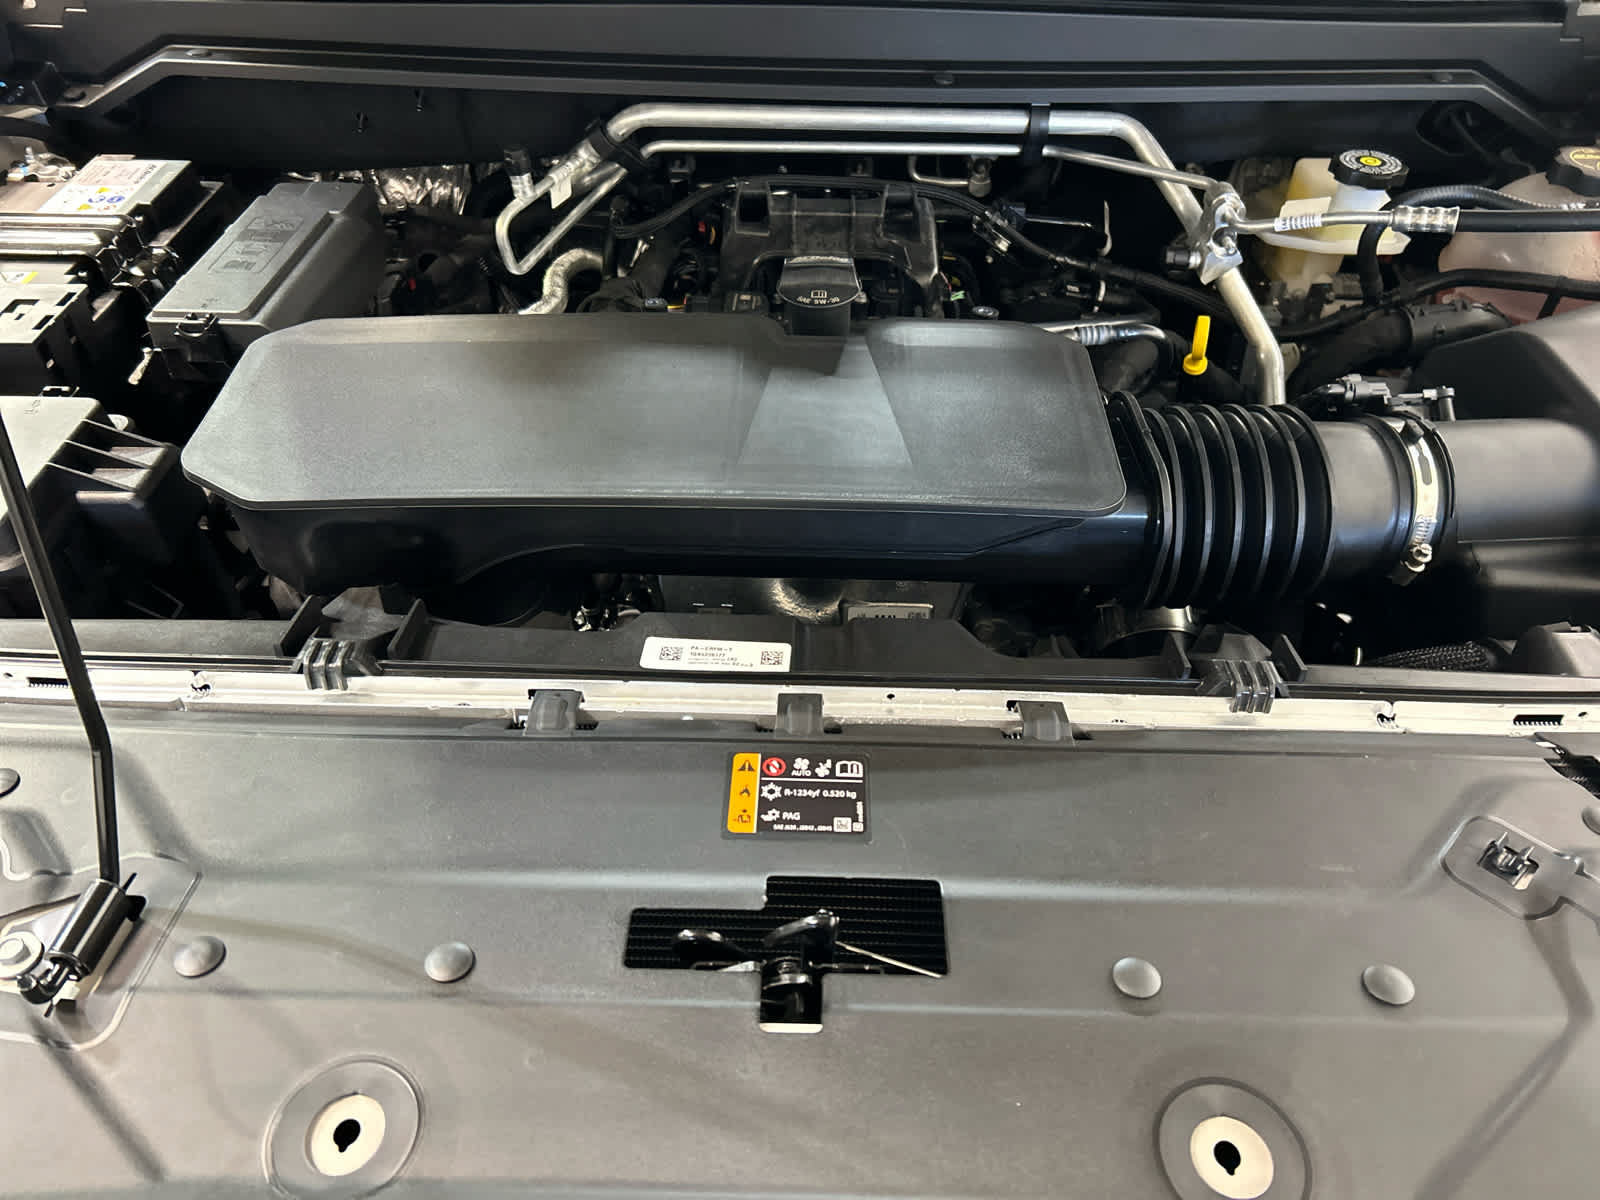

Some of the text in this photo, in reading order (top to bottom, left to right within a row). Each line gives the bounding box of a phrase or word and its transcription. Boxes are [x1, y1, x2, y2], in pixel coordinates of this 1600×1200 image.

[784, 788, 857, 799] R-1234yf 0.520 kg
[782, 812, 801, 821] PAG
